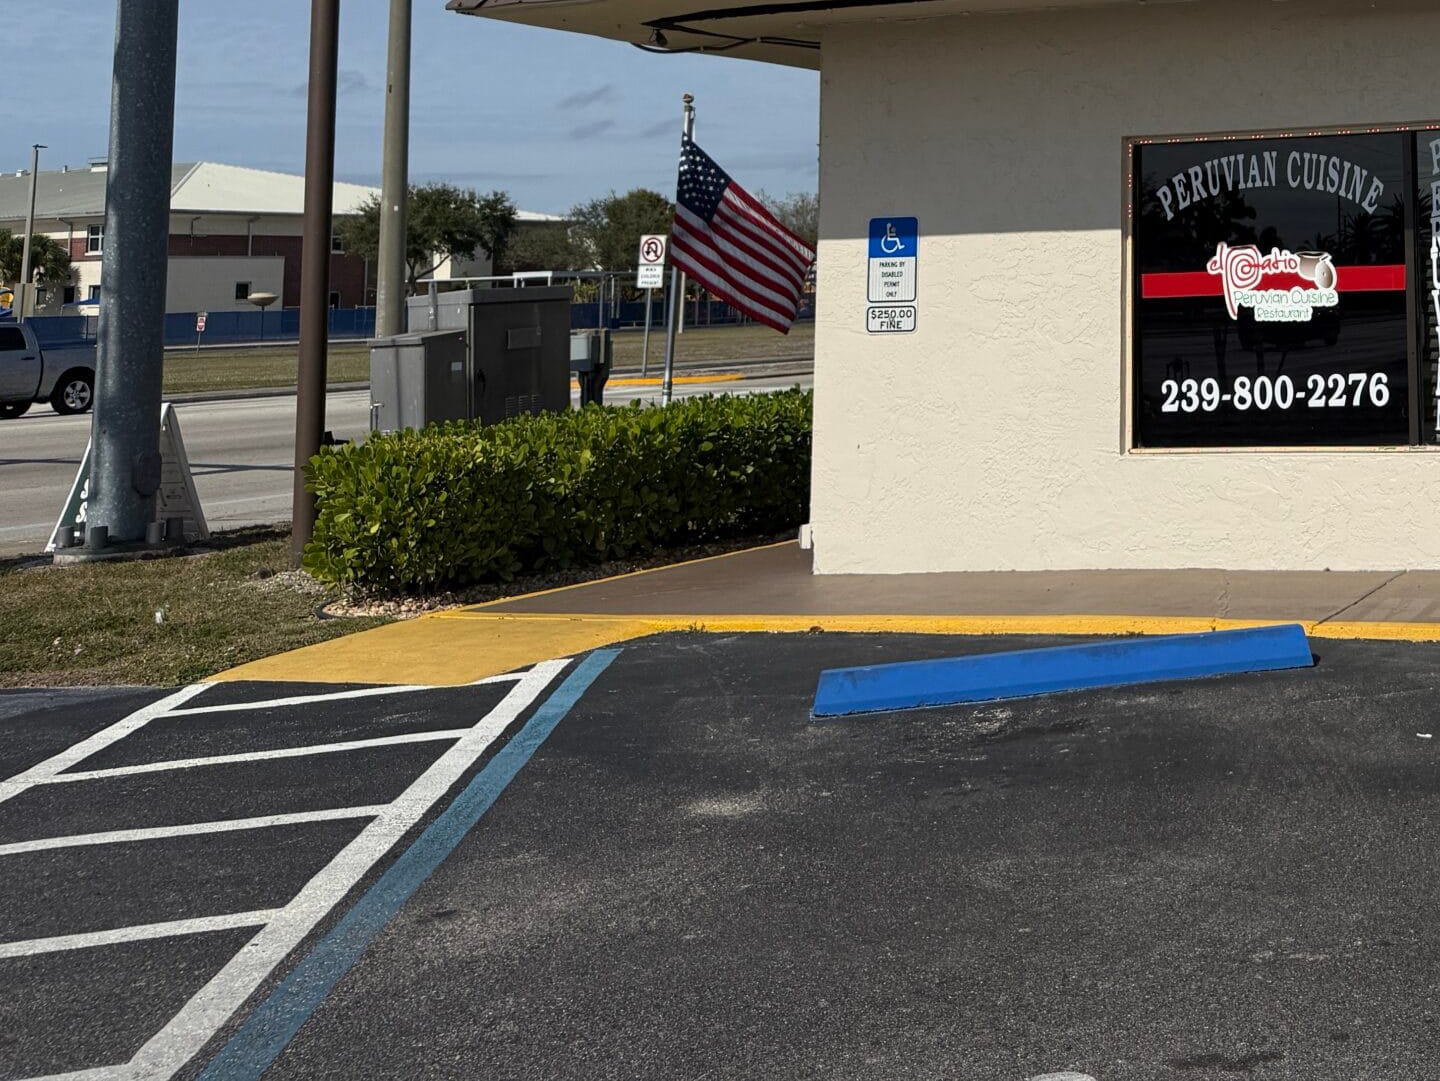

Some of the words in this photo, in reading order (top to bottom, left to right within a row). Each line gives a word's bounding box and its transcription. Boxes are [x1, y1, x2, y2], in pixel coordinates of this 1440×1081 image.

[1156, 151, 1278, 221] PERUVIAN
[1287, 151, 1384, 214] CUISINE
[1234, 291, 1288, 304] Peruvian
[1291, 290, 1335, 304] Cuisine
[871, 308, 912, 320] $250.00
[1257, 308, 1309, 318] Restaurant
[880, 320, 902, 330] FINE
[1161, 372, 1390, 413] 239-800-2276
